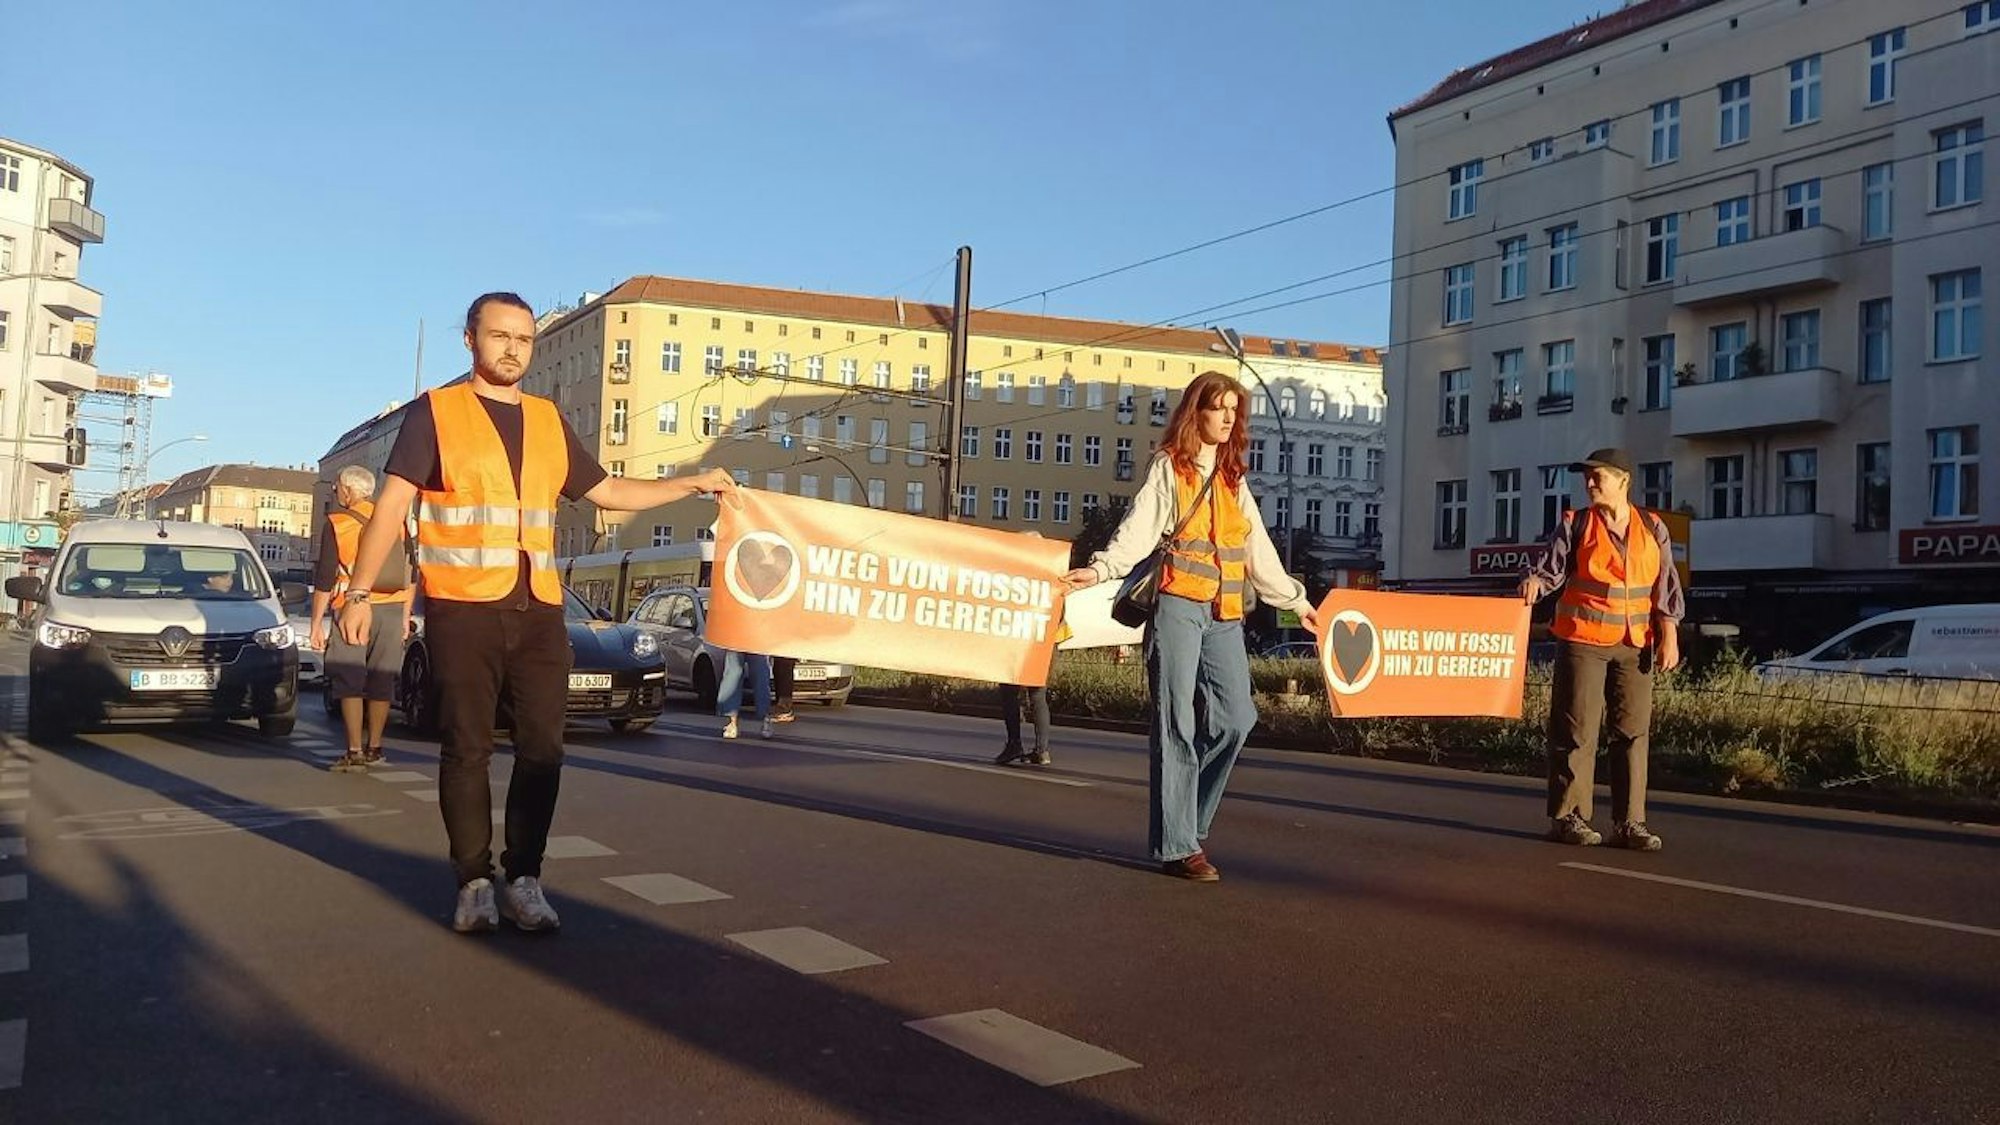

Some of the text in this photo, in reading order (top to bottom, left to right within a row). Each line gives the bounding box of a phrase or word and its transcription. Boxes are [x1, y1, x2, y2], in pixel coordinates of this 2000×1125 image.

[1913, 534, 2000, 557] PAPA
[1477, 552, 1531, 569] PAPA
[807, 544, 1052, 608] WEG VON FOSSIL
[804, 580, 1051, 643] HIN ZU GERECHT
[1382, 629, 1516, 655] WEG VON FOSSIL
[1384, 654, 1515, 679] HIN ZU GERECHT
[142, 673, 151, 686] B
[584, 675, 610, 687] 6307
